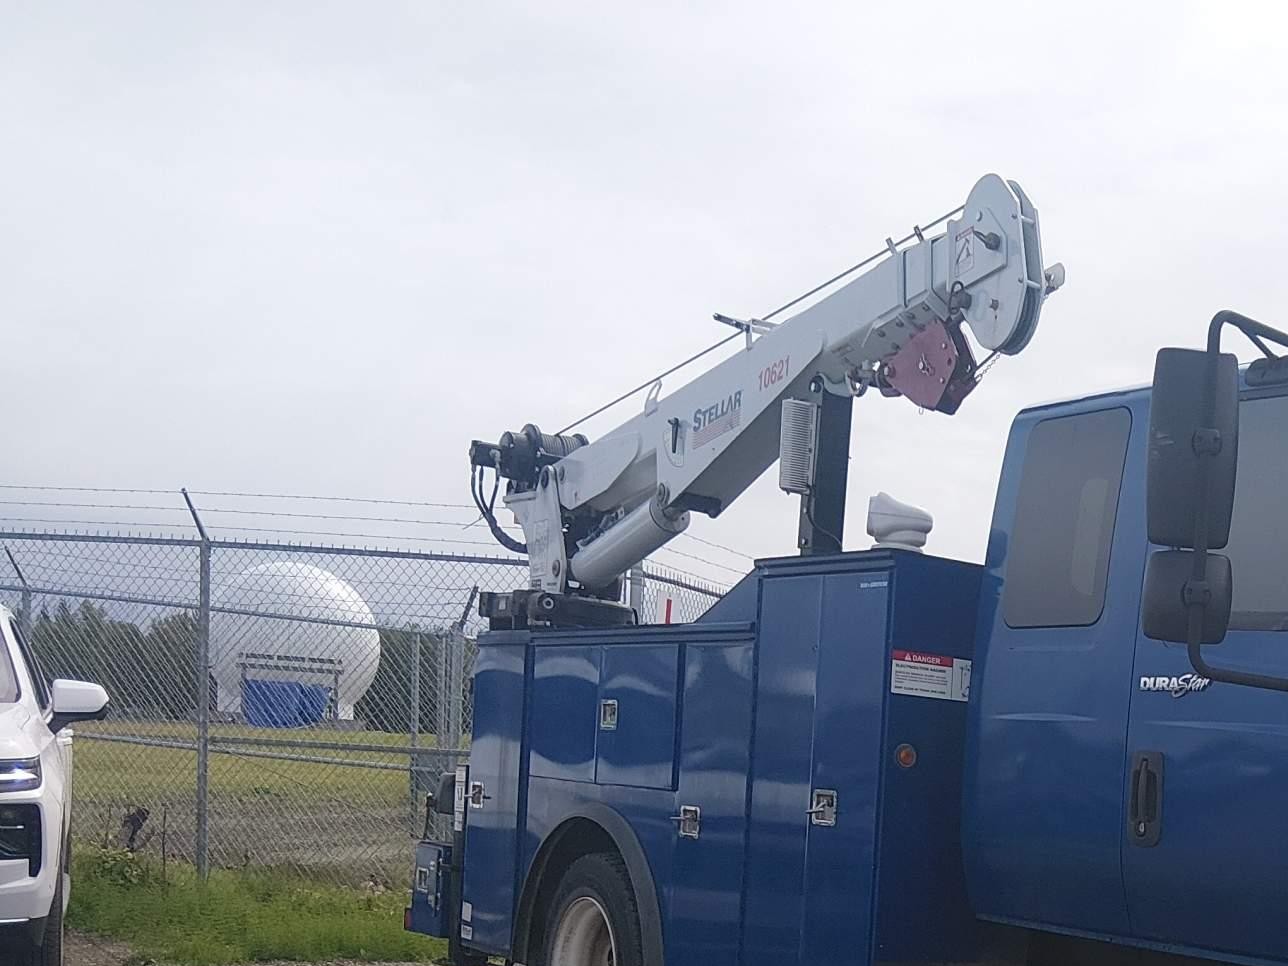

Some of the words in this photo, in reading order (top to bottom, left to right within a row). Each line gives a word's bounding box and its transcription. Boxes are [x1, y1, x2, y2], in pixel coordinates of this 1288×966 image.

[758, 355, 790, 391] 10621
[693, 390, 742, 433] STELLAR
[912, 654, 941, 664] DANGER
